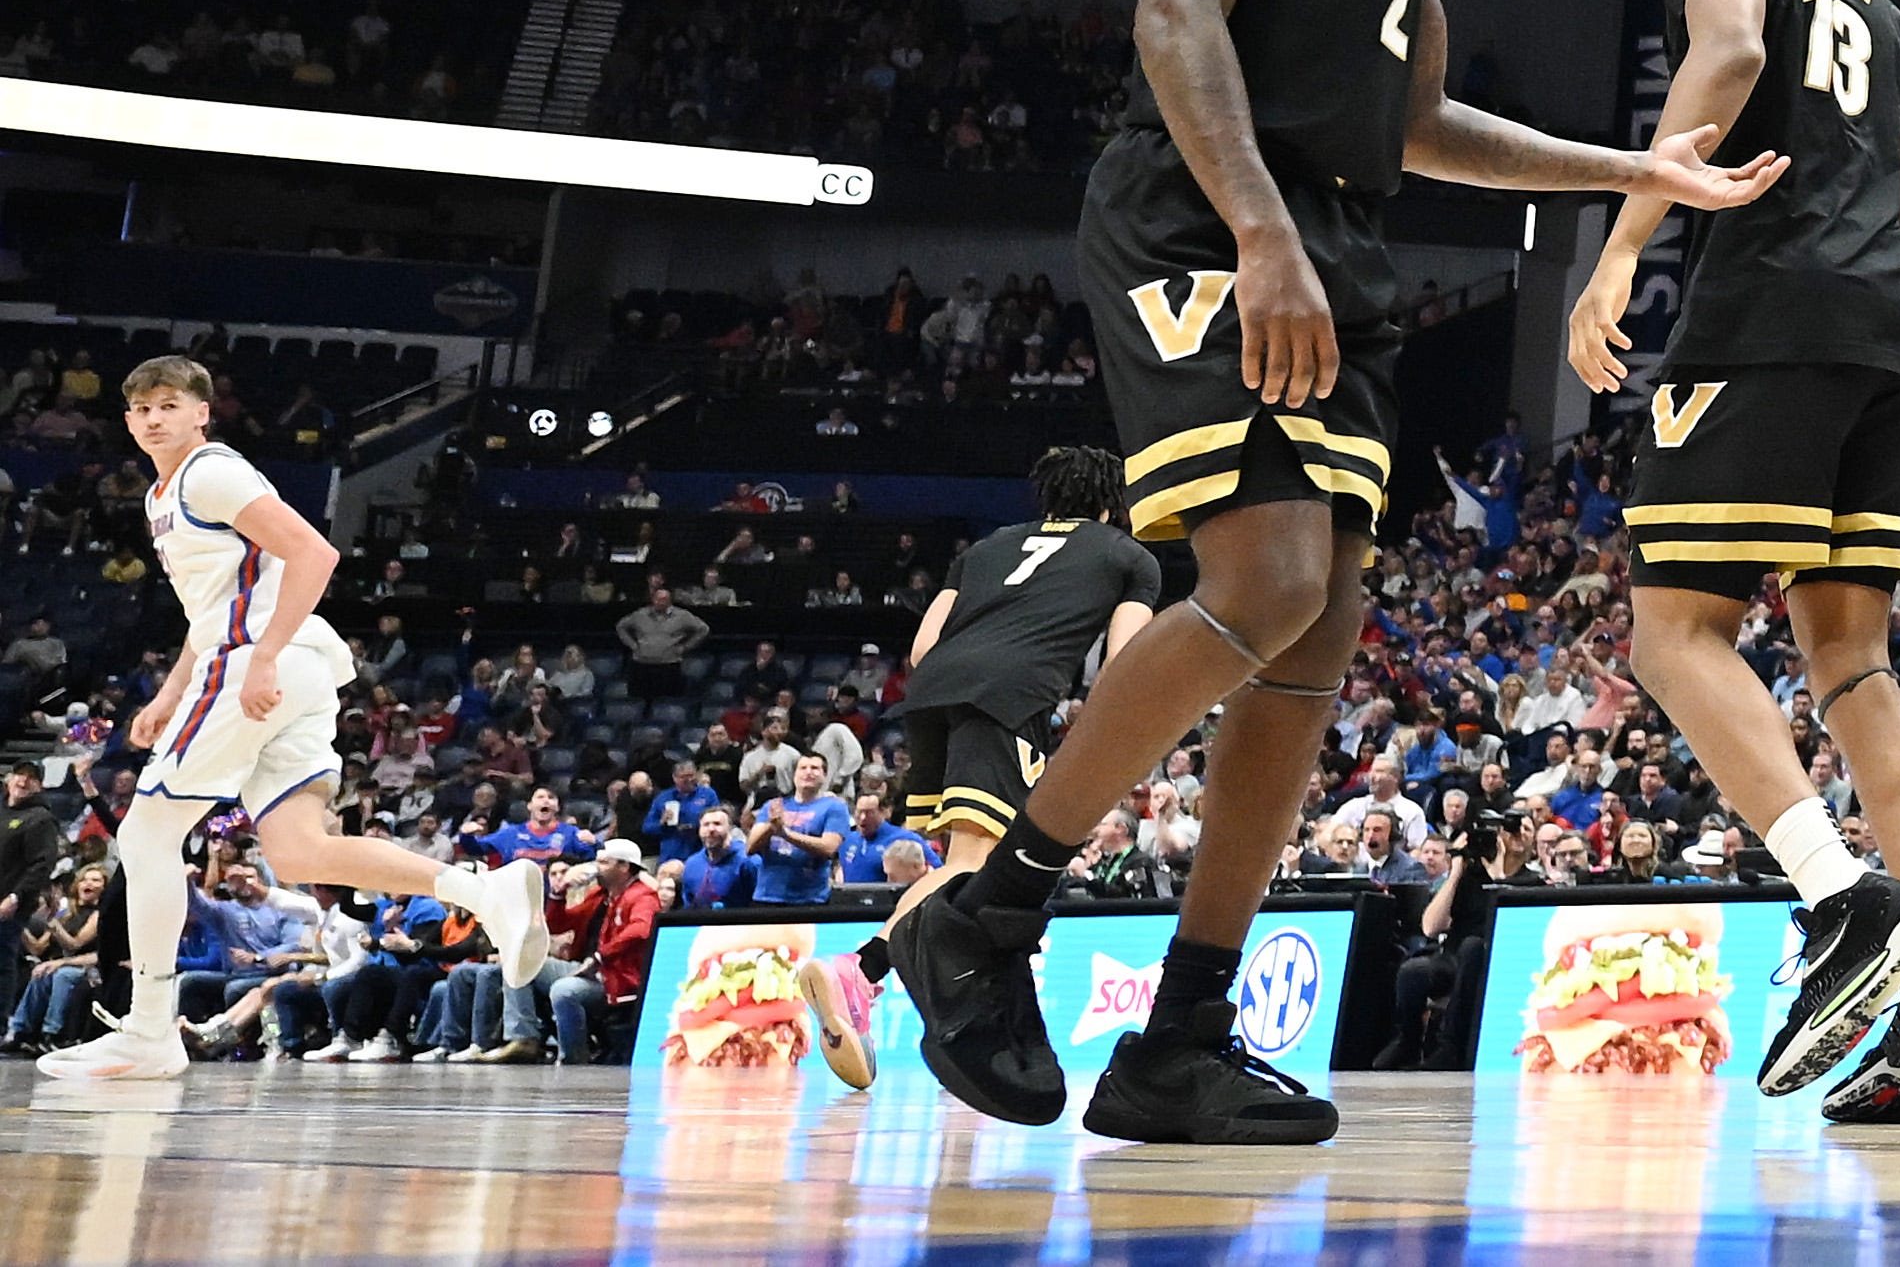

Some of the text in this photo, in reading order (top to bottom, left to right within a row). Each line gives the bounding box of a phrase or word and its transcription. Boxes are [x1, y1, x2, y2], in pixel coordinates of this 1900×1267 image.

[822, 173, 863, 197] CC
[1127, 270, 1237, 362] V
[1651, 381, 1728, 448] V
[1003, 536, 1067, 585] 7
[1092, 979, 1155, 1014] SON
[1242, 935, 1316, 1049] SEC
